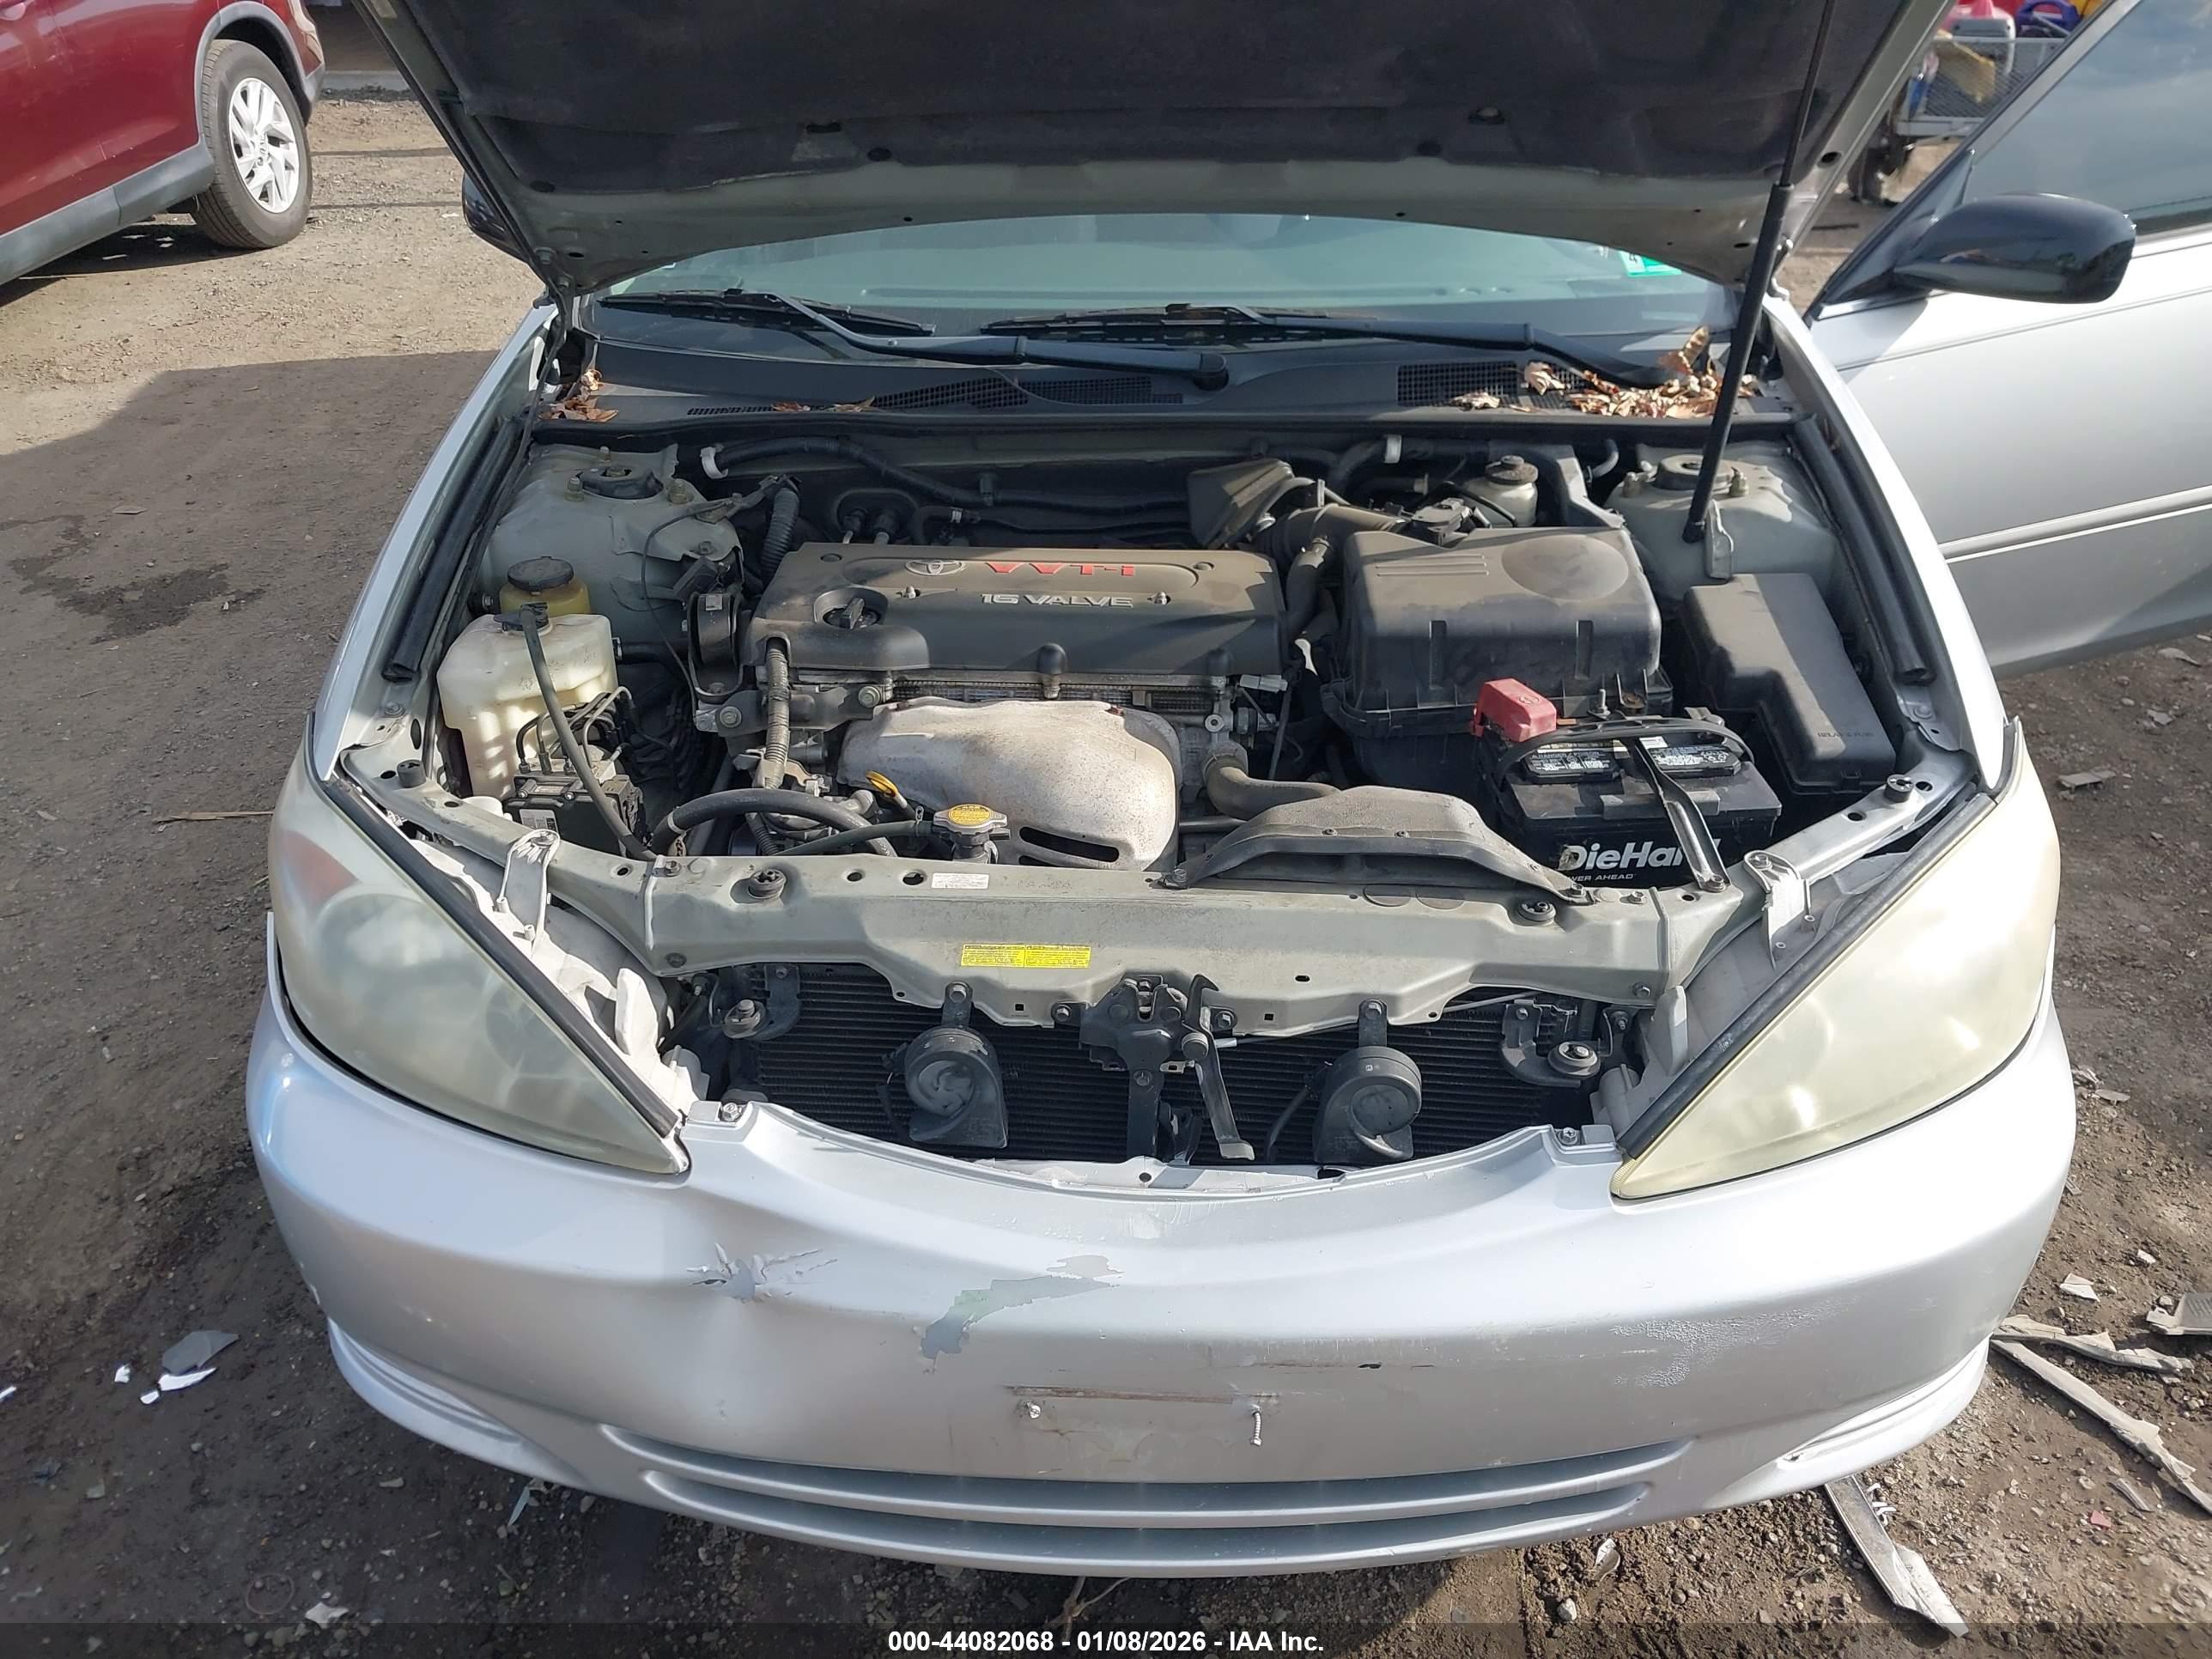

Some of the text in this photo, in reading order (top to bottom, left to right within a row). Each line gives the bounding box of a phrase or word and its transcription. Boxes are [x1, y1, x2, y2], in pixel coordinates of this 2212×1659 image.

[981, 593, 1133, 609] 16 VALVE
[1557, 838, 1722, 872] DieHar
